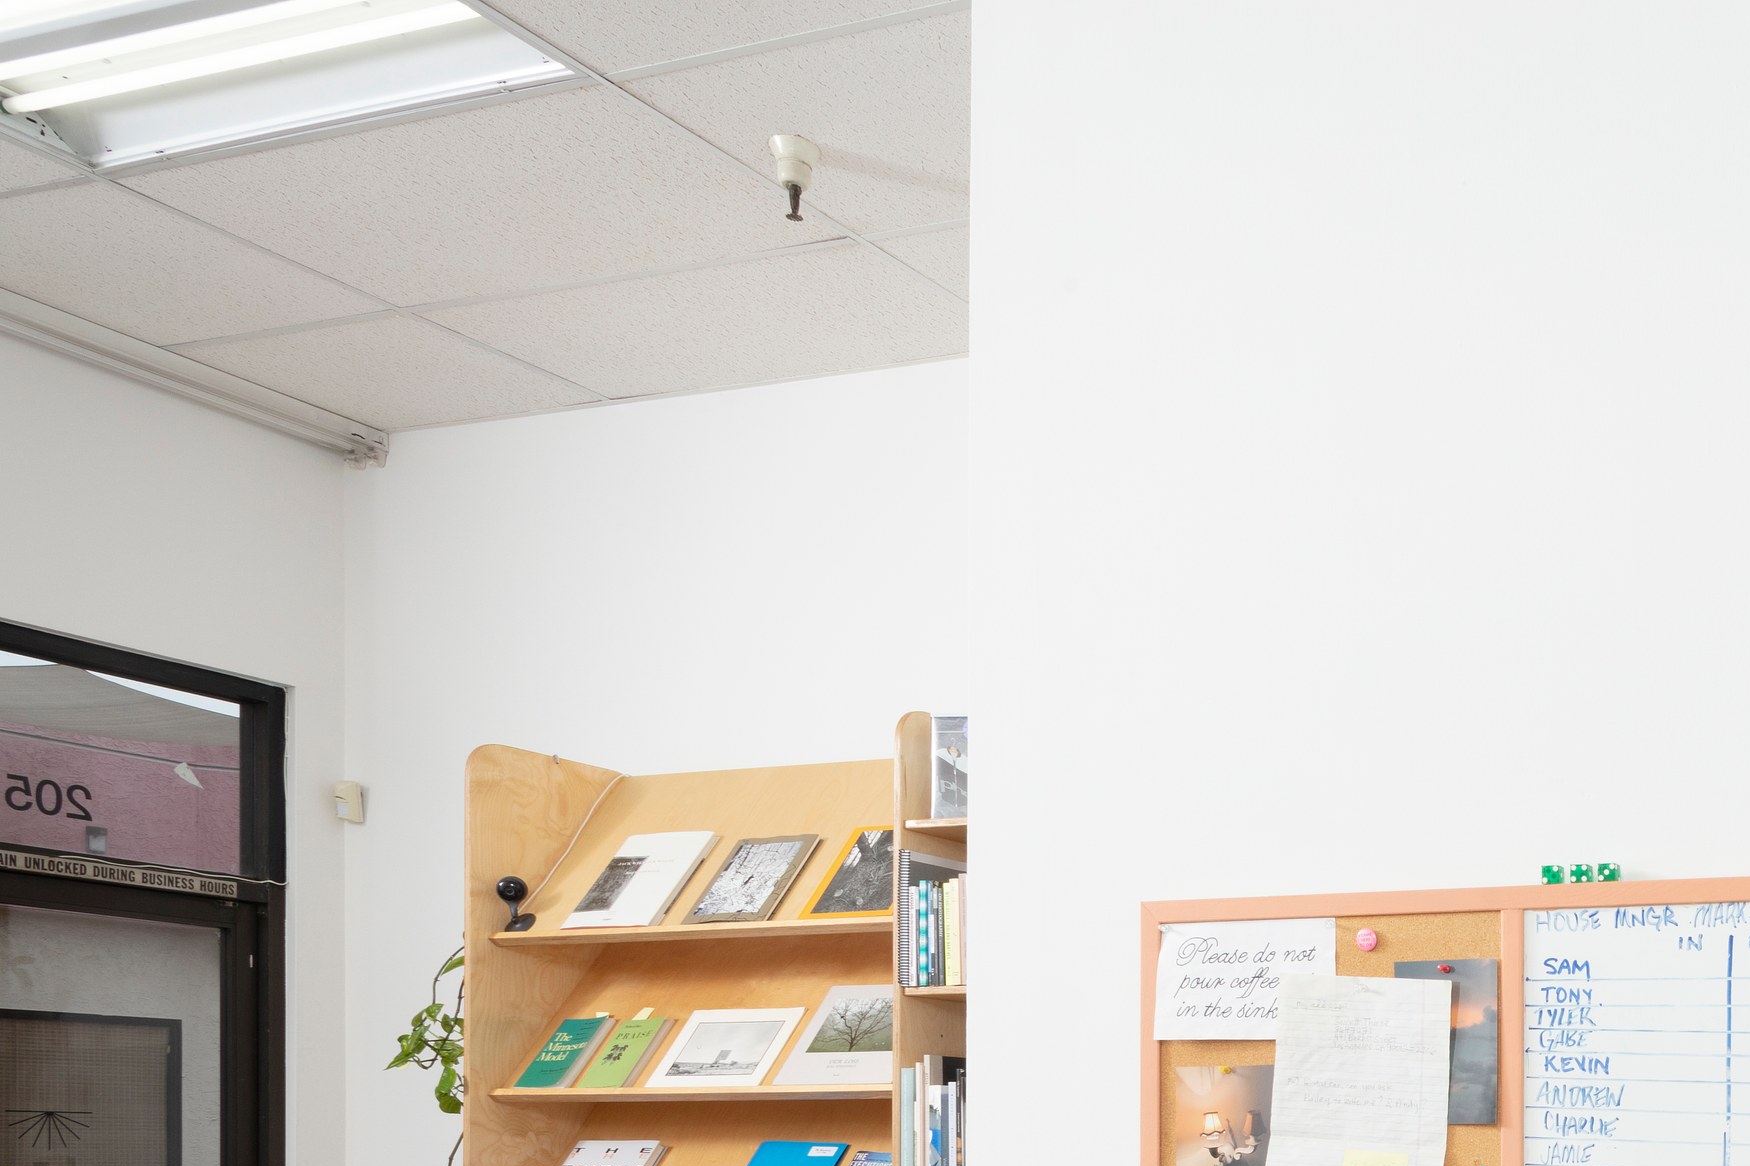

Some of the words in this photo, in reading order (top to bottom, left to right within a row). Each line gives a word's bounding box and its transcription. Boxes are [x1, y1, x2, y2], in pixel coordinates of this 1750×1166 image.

[24, 856, 88, 876] UNLOCKED
[92, 866, 136, 883] DURING
[141, 872, 196, 891] BUSINESS
[200, 880, 236, 896] HOURS
[1536, 909, 1602, 933] HOUSE
[1614, 906, 1680, 931] MNGR
[1175, 936, 1249, 967] Please
[1252, 942, 1277, 964] do
[1283, 946, 1317, 963] not
[1678, 934, 1704, 951] IN
[1543, 957, 1591, 982] SAM
[1173, 973, 1226, 998] pour
[1230, 966, 1281, 1000] coffee
[1541, 986, 1593, 1006] TONY
[1176, 1001, 1199, 1018] in
[1203, 997, 1233, 1019] the
[1236, 997, 1279, 1019] sink
[1535, 1006, 1597, 1027] TYLER
[553, 1032, 573, 1042] The
[615, 1030, 654, 1040] PRAISE
[1539, 1029, 1590, 1051] GABE
[536, 1051, 569, 1062] Model
[1544, 1055, 1610, 1075] KEVIN
[1536, 1081, 1625, 1108] ANDREW
[1544, 1110, 1620, 1138] CHARLIE
[854, 1152, 868, 1161] THE
[1541, 1142, 1595, 1166] JAMIE
